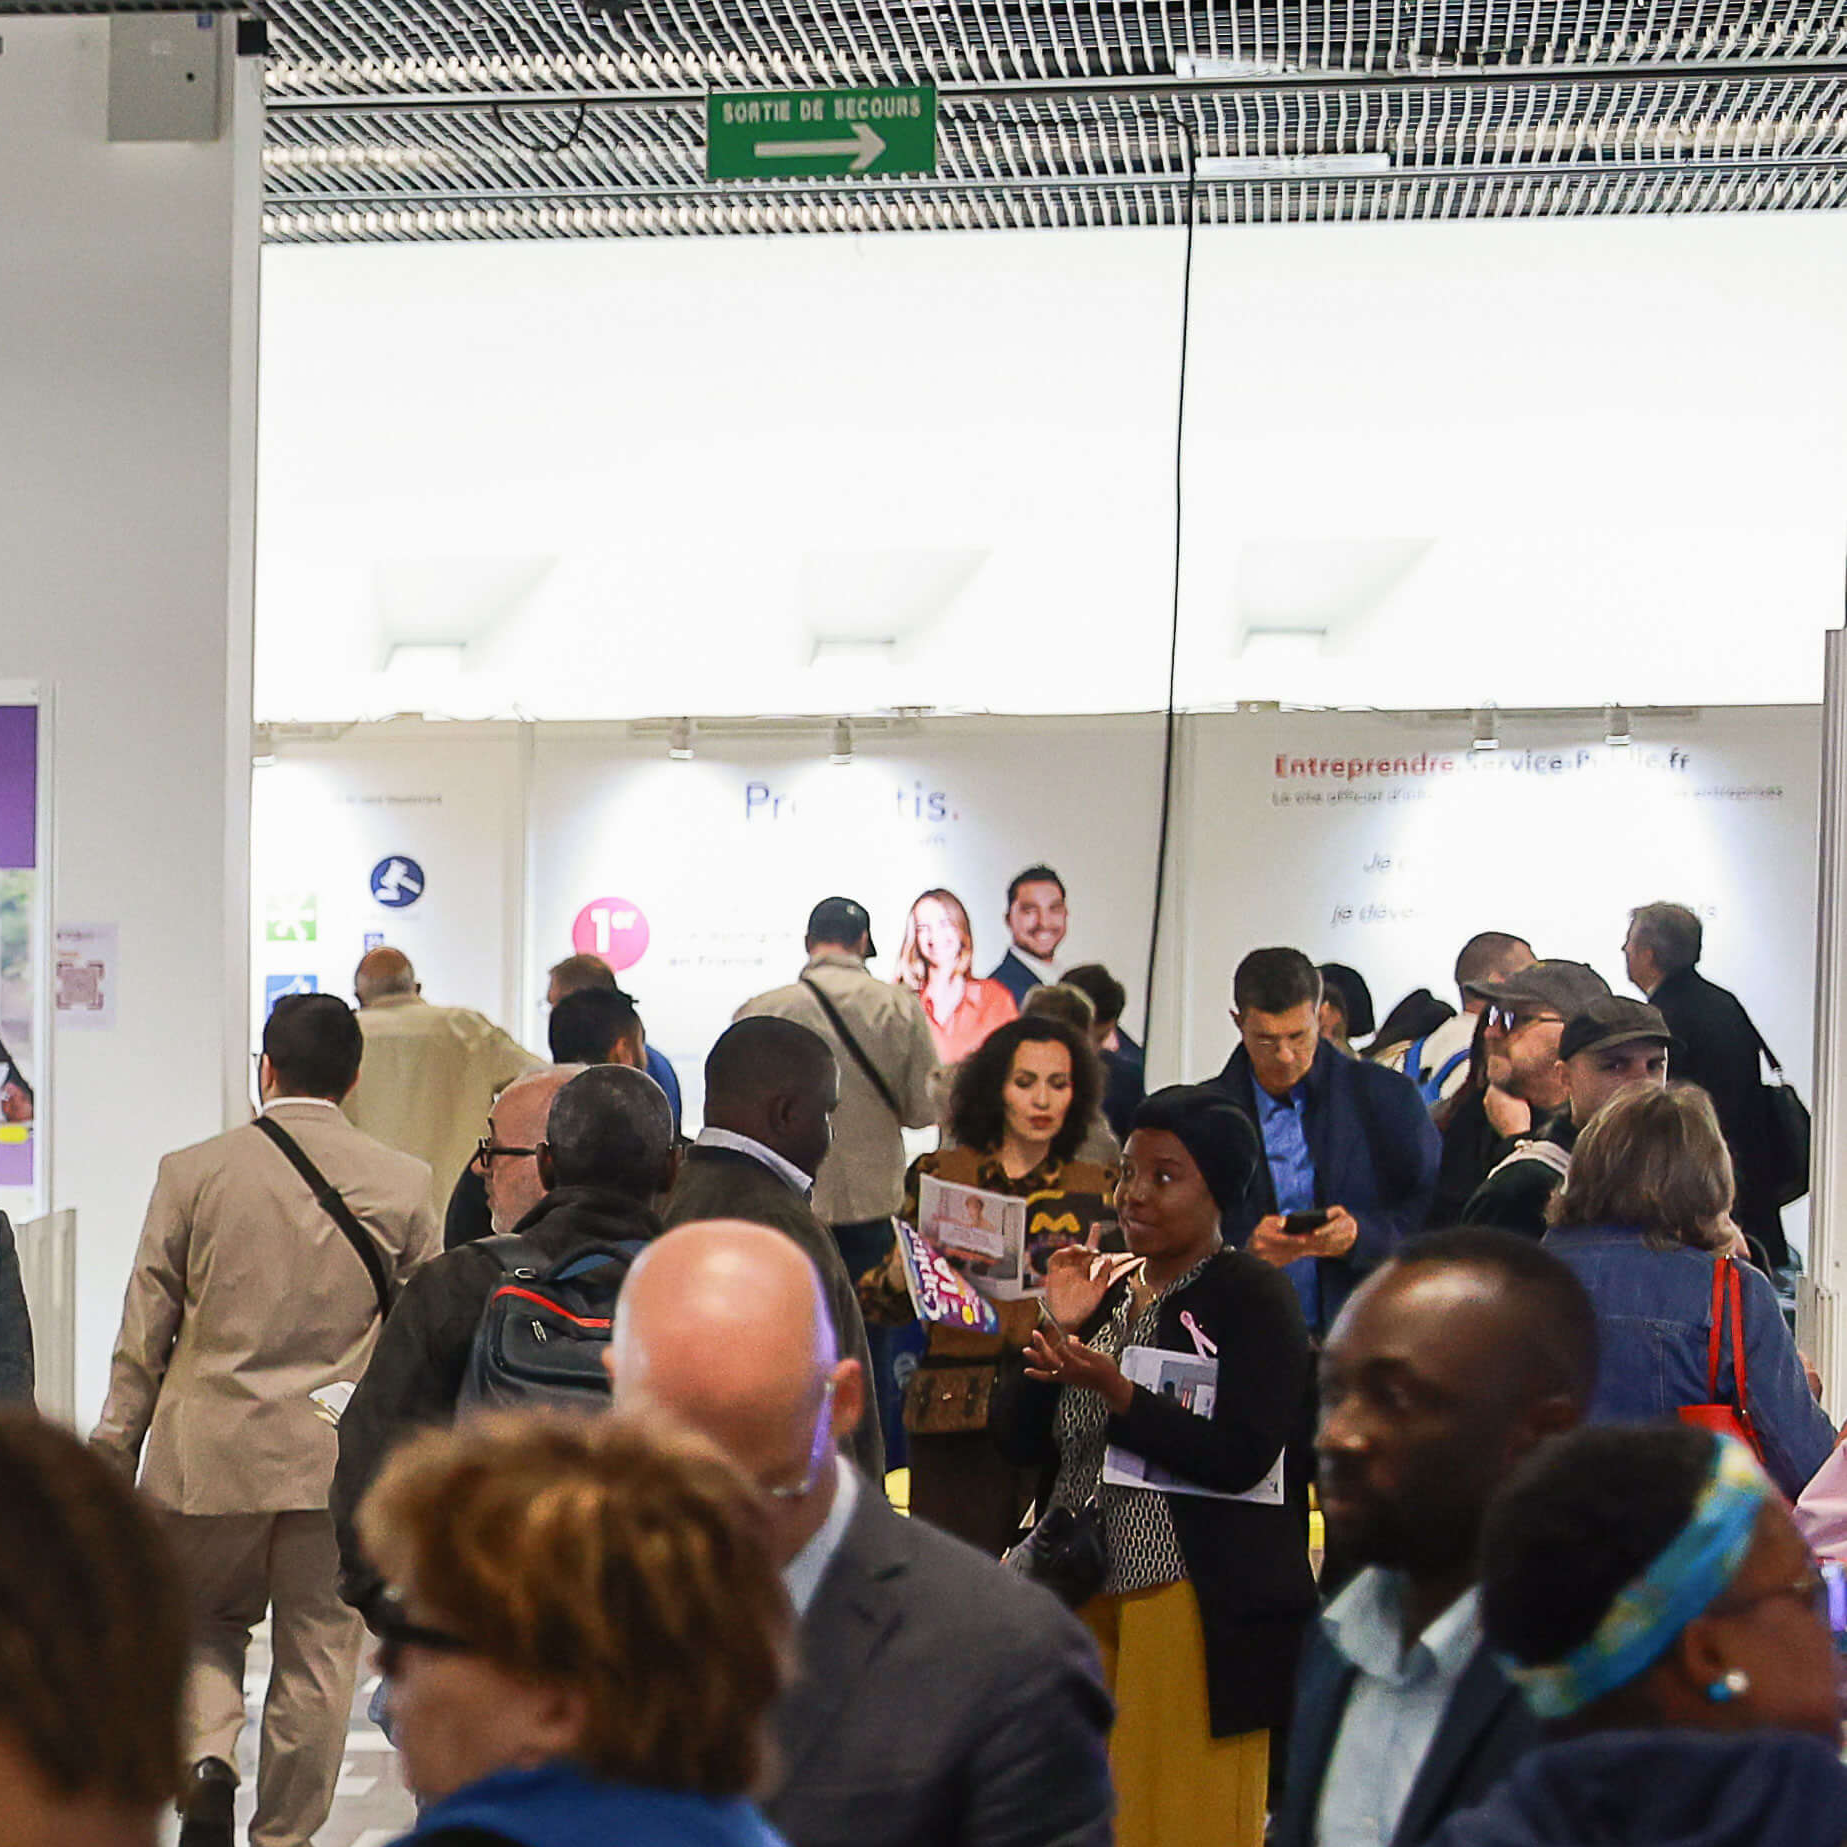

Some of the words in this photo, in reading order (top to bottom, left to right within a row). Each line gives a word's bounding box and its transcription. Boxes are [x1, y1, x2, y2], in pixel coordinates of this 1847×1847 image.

[722, 99, 792, 124] SORTIE
[799, 99, 824, 122] DE
[834, 95, 922, 119] SECOURS
